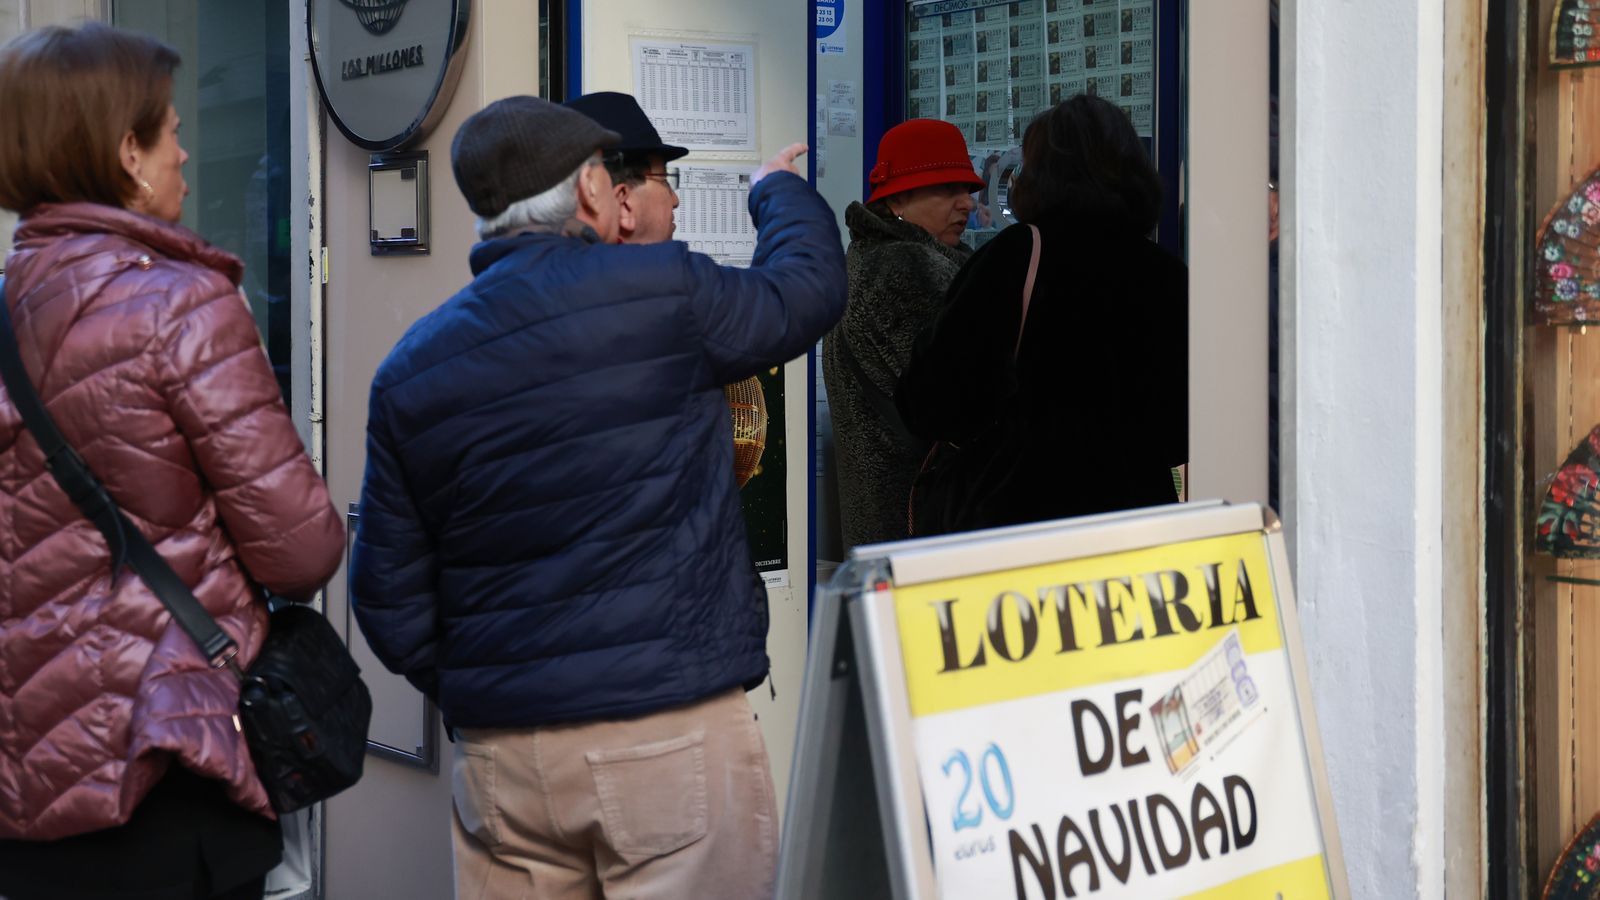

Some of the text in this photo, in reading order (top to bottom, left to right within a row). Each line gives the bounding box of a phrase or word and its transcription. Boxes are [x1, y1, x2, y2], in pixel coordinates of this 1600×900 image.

[342, 44, 424, 81] LOS MILLONES
[929, 559, 1262, 675] LOTERIA
[1071, 688, 1150, 777] DE
[941, 742, 1015, 832] 20
[1008, 775, 1258, 900] NAVIDAD
